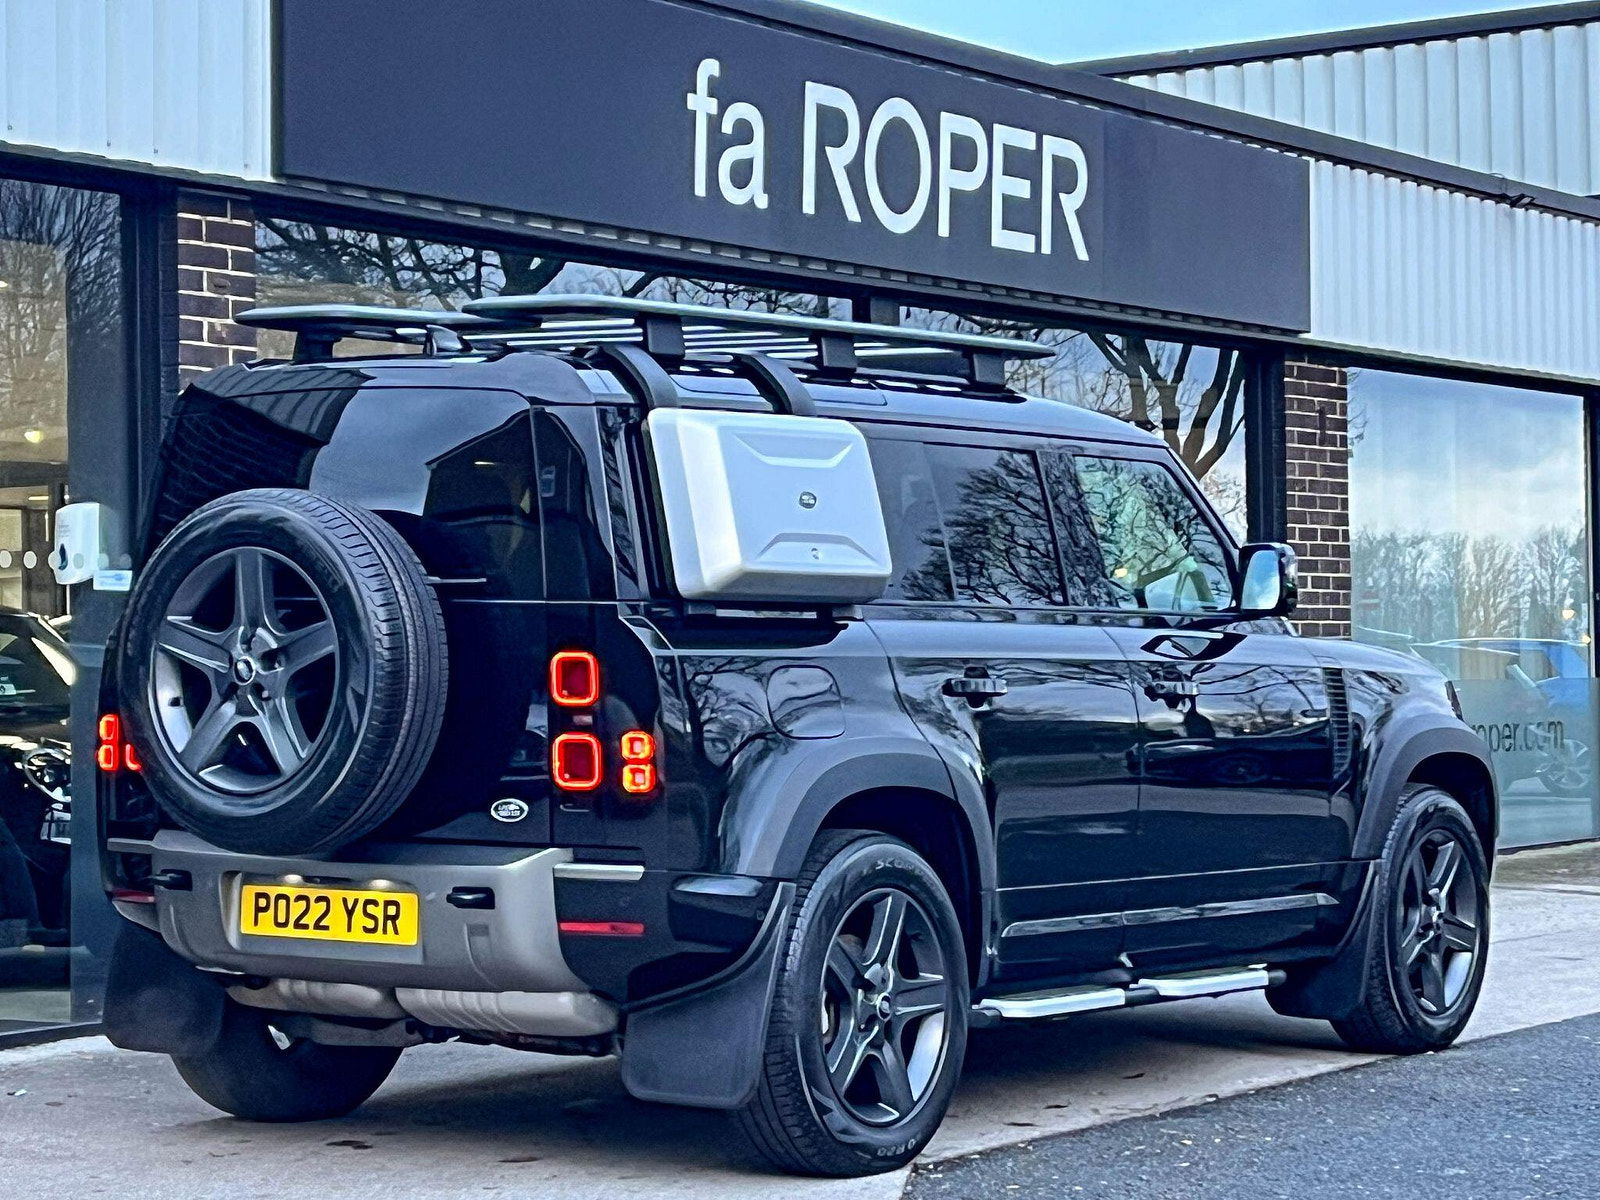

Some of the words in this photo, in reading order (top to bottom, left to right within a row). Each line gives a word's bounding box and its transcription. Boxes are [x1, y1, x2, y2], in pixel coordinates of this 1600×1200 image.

[687, 58, 768, 209] fa
[802, 81, 1090, 261] ROPER
[253, 892, 331, 931] PO22
[342, 897, 401, 936] YSR
